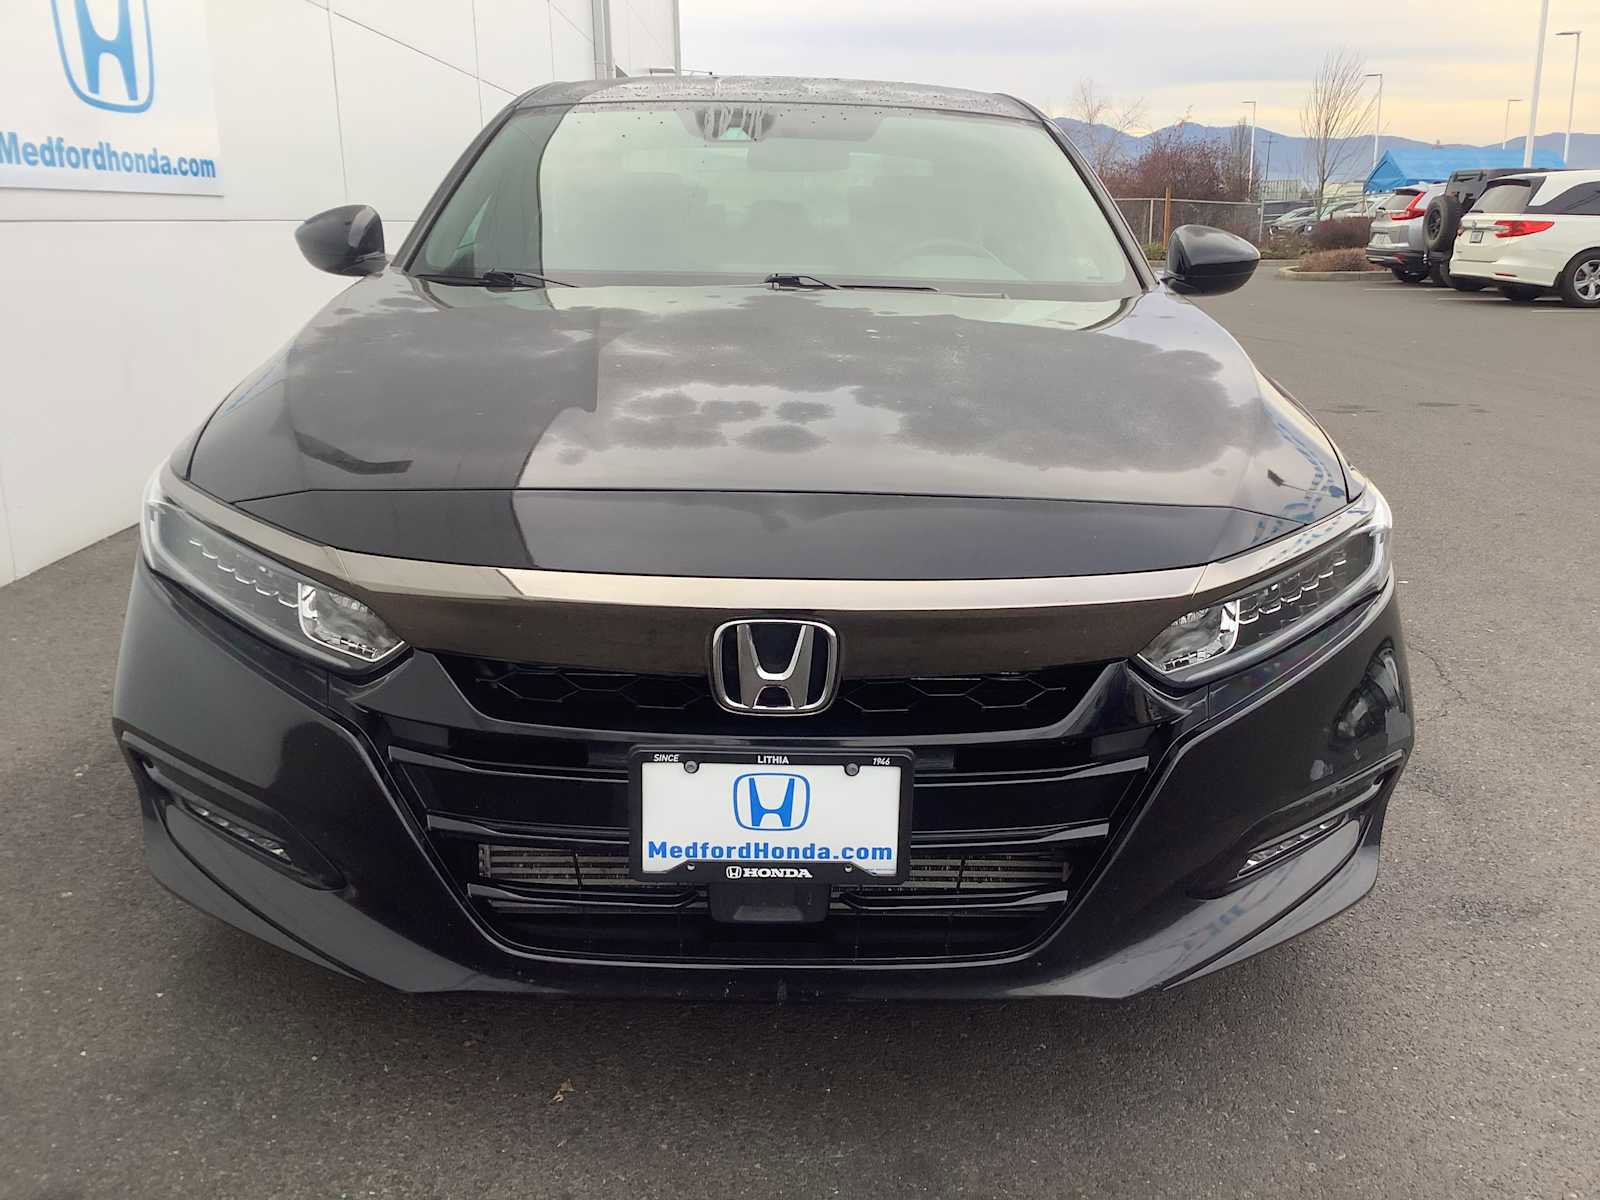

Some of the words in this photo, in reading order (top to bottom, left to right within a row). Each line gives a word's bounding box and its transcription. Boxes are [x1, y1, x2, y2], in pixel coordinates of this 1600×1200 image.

[0, 131, 216, 178] Medfordhonda.com
[653, 753, 680, 762] SINCE
[757, 755, 790, 765] LITHIA
[873, 757, 890, 766] 1946
[648, 840, 892, 860] MedfordHonda.com
[743, 868, 813, 878] HONDA
